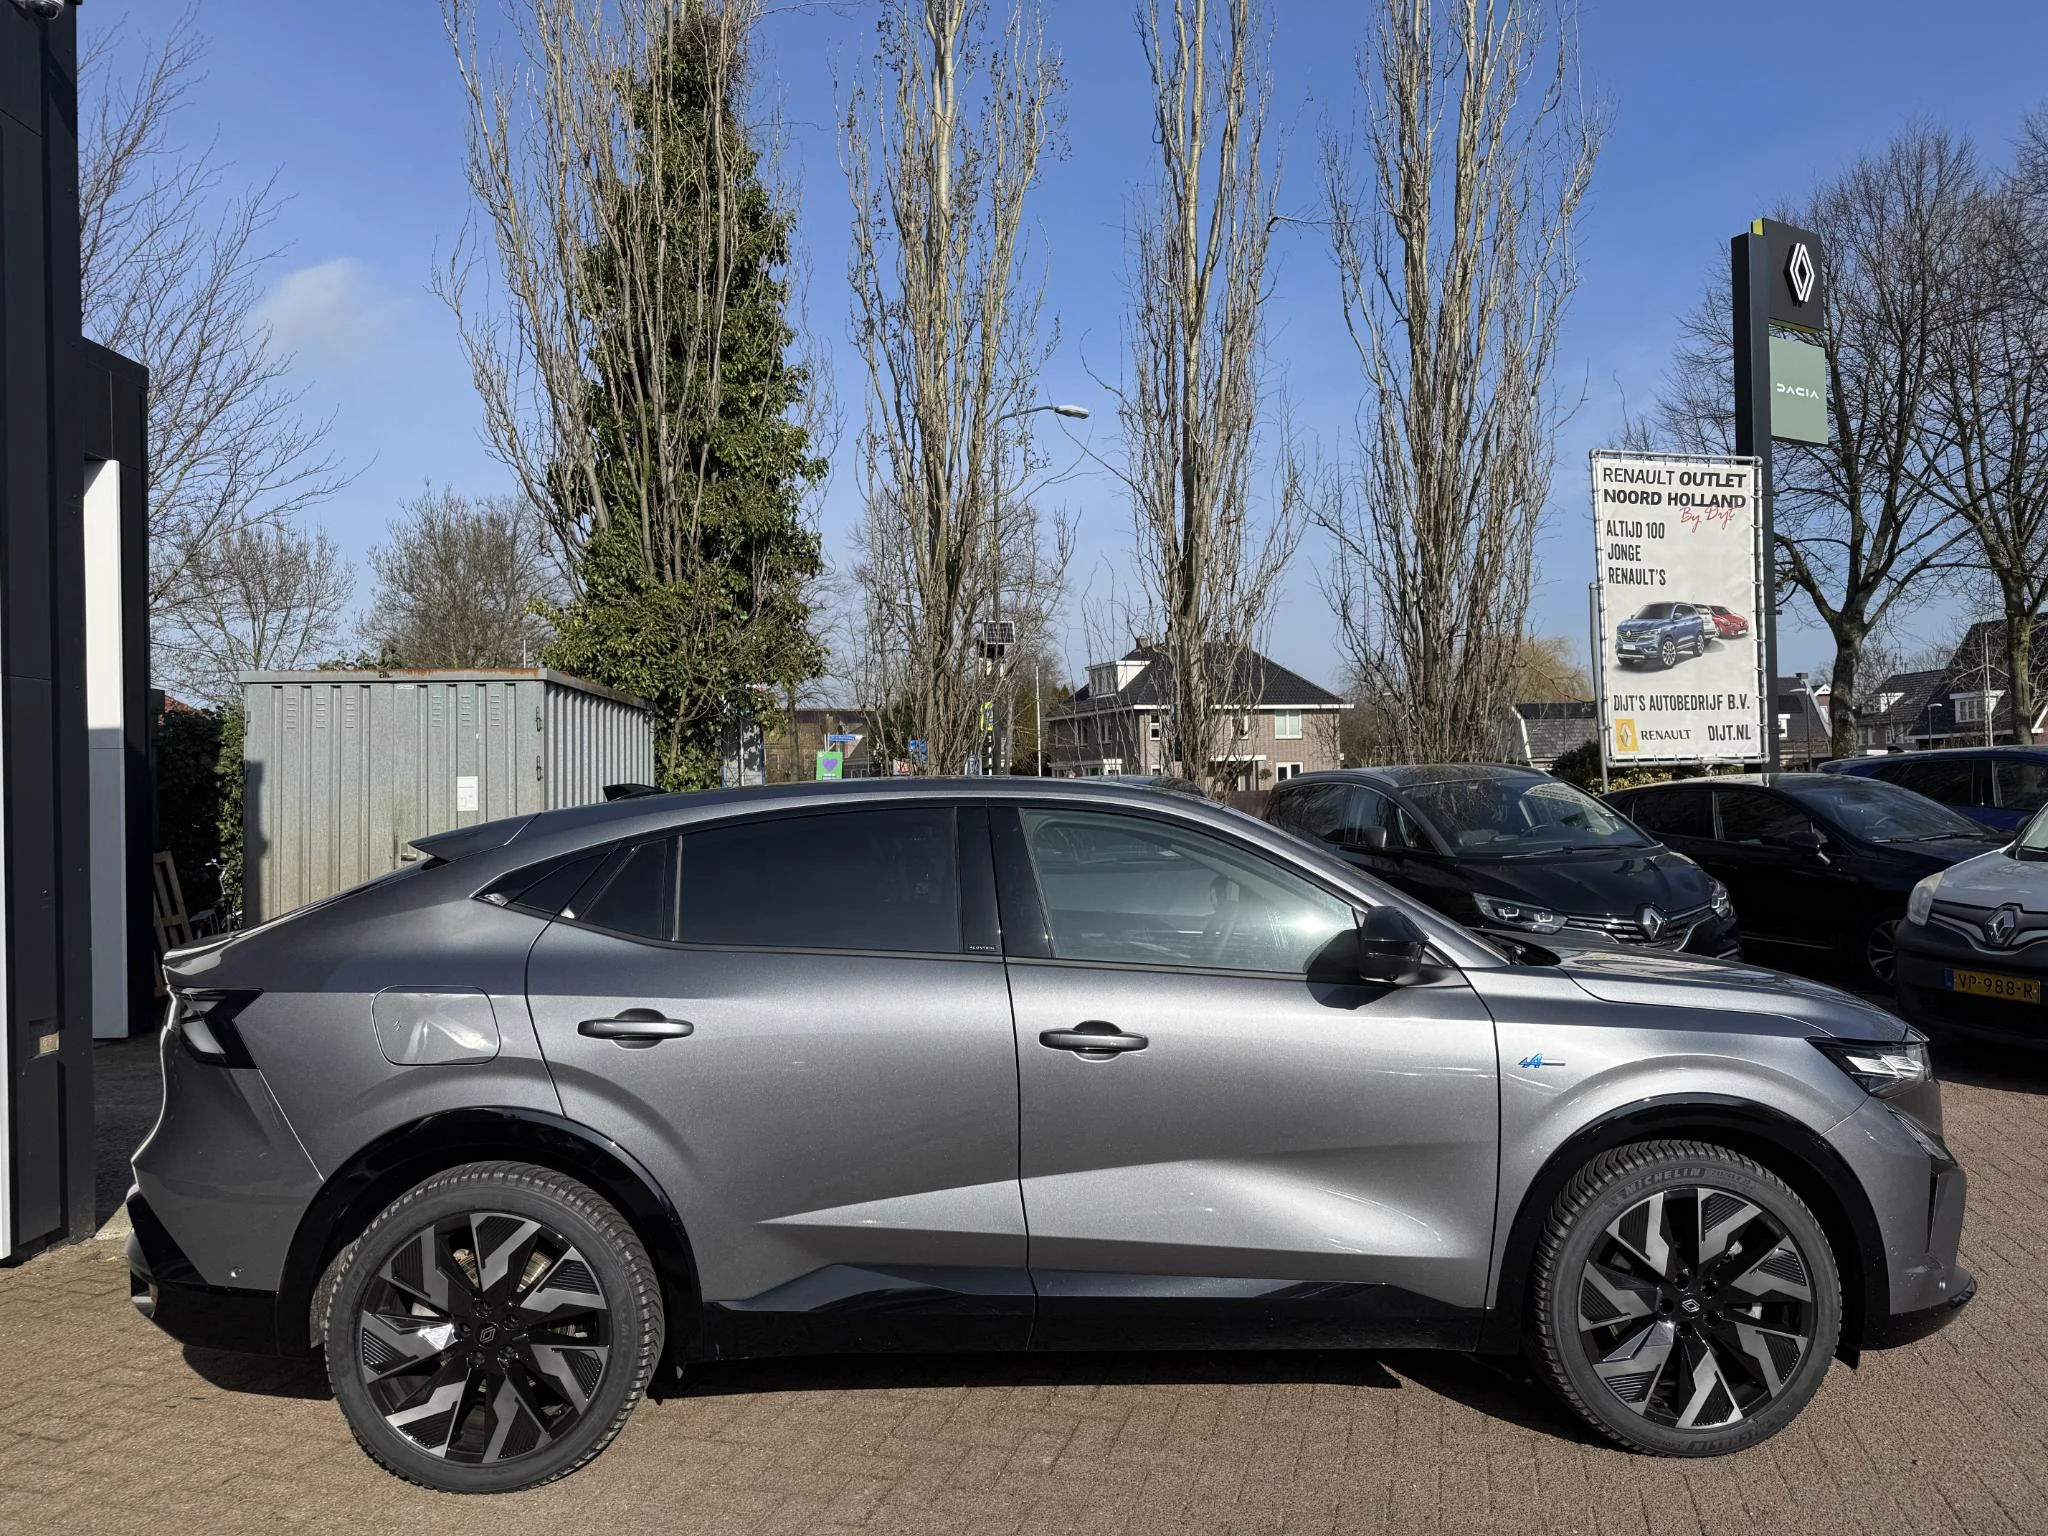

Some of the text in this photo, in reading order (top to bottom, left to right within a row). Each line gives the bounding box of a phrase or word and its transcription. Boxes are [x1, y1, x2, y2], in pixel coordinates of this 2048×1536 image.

[1776, 382, 1820, 400] DACIA
[1603, 467, 1747, 488] RENAULT OUTLET
[1603, 488, 1747, 509] NOORD HOLLAND
[1606, 519, 1665, 539] ALTIJD 100
[1679, 506, 1702, 533] By
[1607, 543, 1642, 562] JONGE
[1608, 566, 1667, 586] RENAULT'S
[1613, 693, 1750, 712] DIJT'S AUTOBEDRIJF B.V.
[1641, 729, 1692, 741] RENAULT
[1707, 724, 1752, 741] DIJT.NL
[1958, 973, 2033, 999] VP-988-R
[1625, 1167, 1703, 1195] MICHELIN
